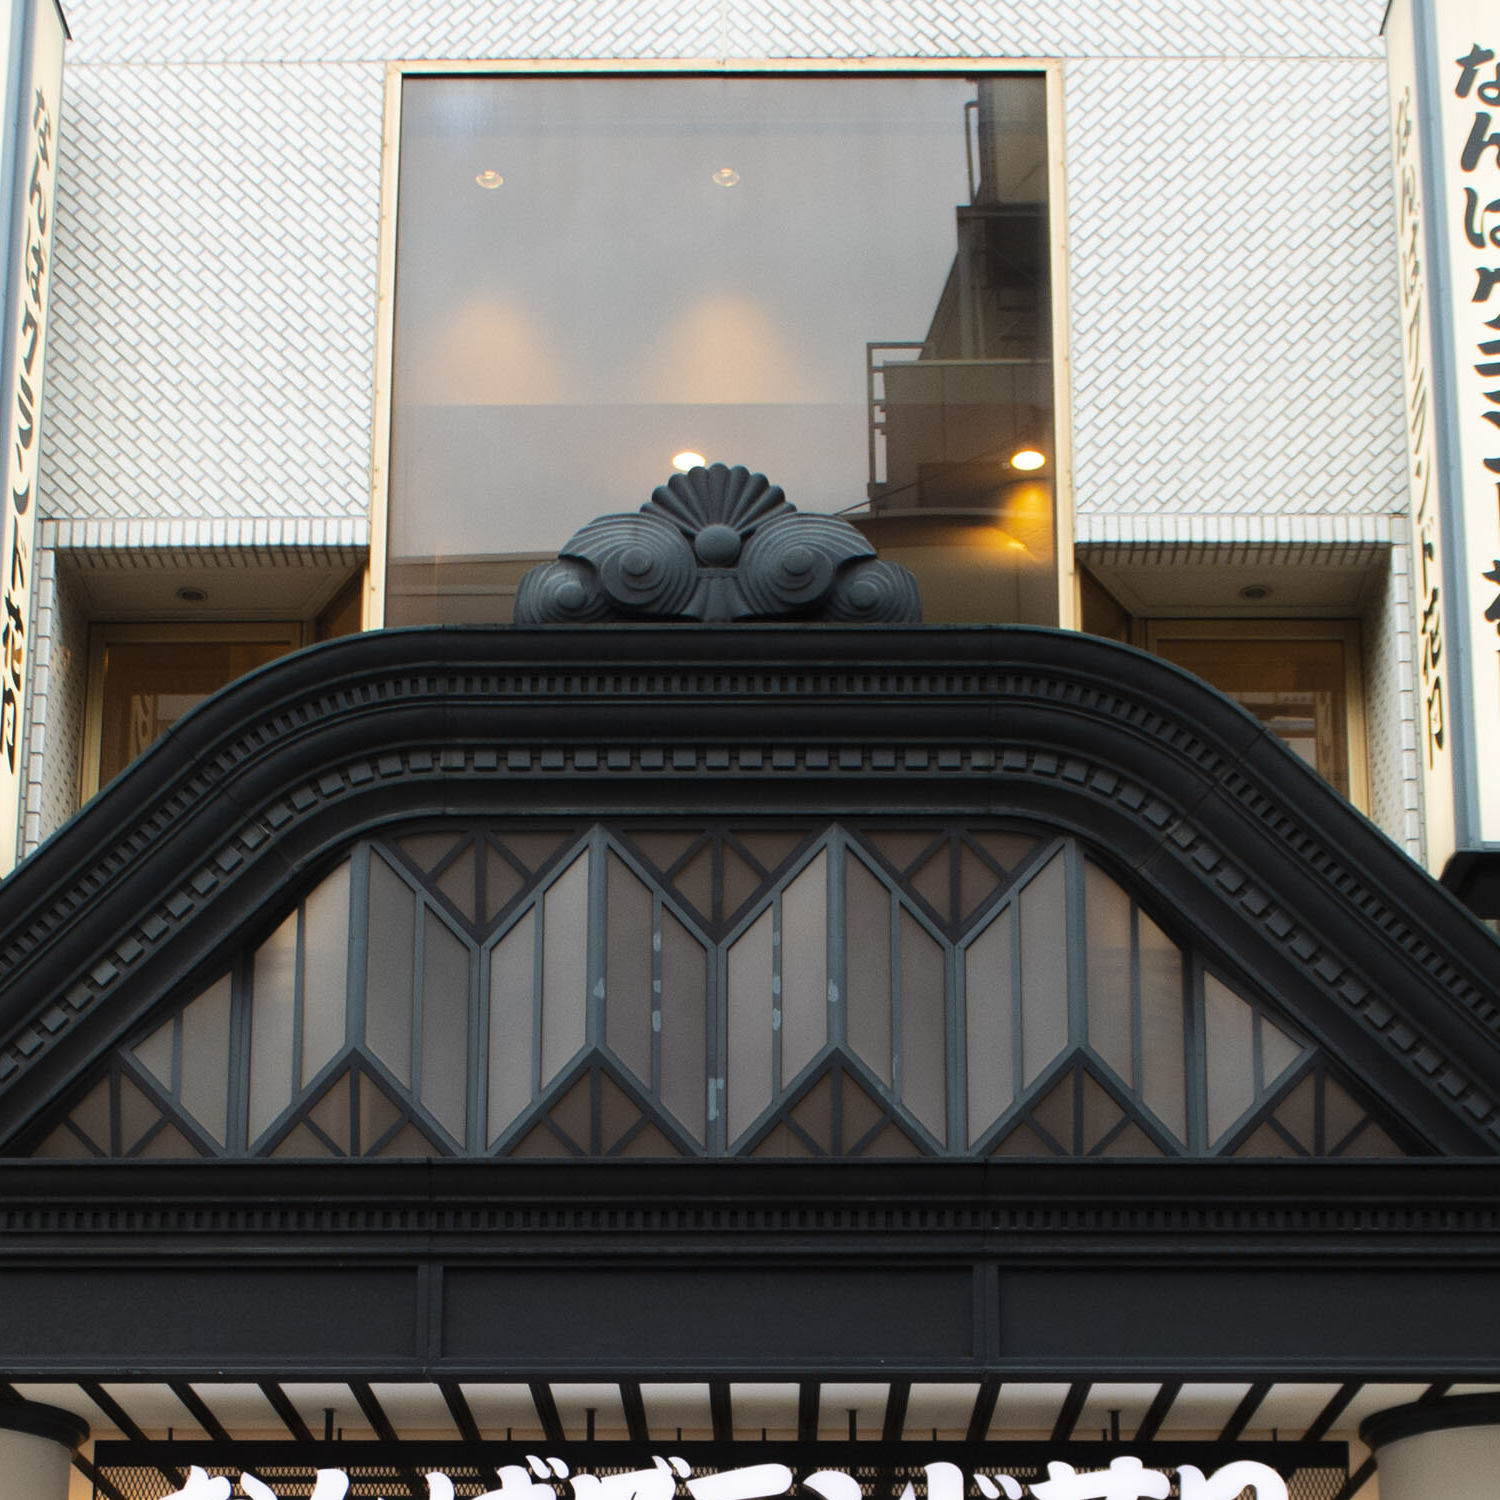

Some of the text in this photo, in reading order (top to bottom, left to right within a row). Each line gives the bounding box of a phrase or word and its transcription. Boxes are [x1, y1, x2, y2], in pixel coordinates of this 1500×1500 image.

[0, 84, 54, 778] なんばグランド花月
[1395, 84, 1446, 772] なんばグランド花月
